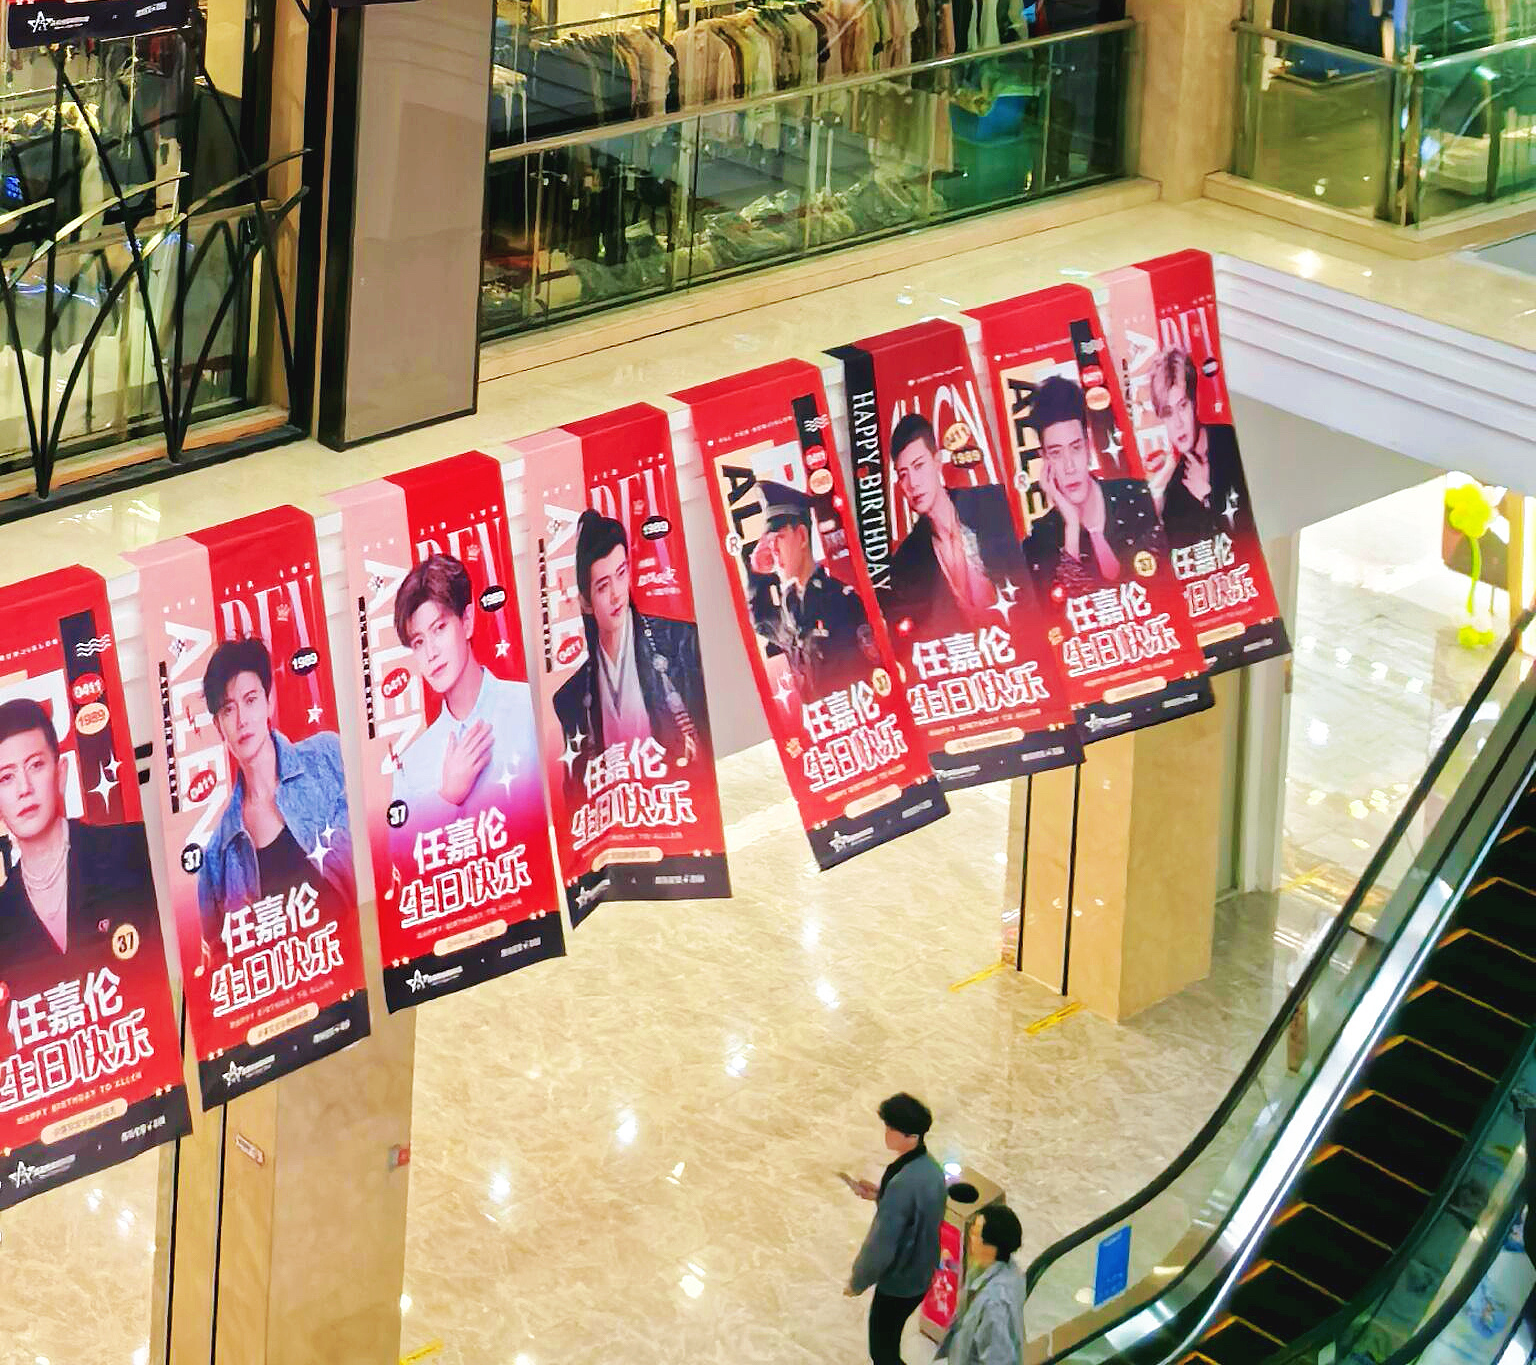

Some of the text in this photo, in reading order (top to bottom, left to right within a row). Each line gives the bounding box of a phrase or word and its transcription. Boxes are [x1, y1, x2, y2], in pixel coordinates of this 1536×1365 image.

[852, 389, 894, 594] HAPPY BIRTHDAY
[1171, 533, 1236, 582] 任嘉伦
[1065, 580, 1153, 631] 任嘉伦
[911, 628, 1017, 675] 任嘉伦
[1064, 615, 1181, 677] 生日快乐
[73, 679, 104, 698] 0411
[801, 681, 883, 743] 任嘉伦
[907, 663, 1052, 725] 生日快乐
[584, 735, 669, 798] 任嘉伦
[801, 714, 910, 794] 生日快乐
[389, 803, 408, 824] 37
[412, 810, 509, 875] 任嘉伦
[571, 782, 699, 852] 生日快乐
[183, 849, 201, 869] 37
[397, 845, 534, 931] 生日快乐
[116, 929, 135, 952] 37
[220, 882, 321, 958] 任嘉伦
[209, 922, 345, 1019] 生日快乐
[6, 965, 124, 1051] 任嘉伦
